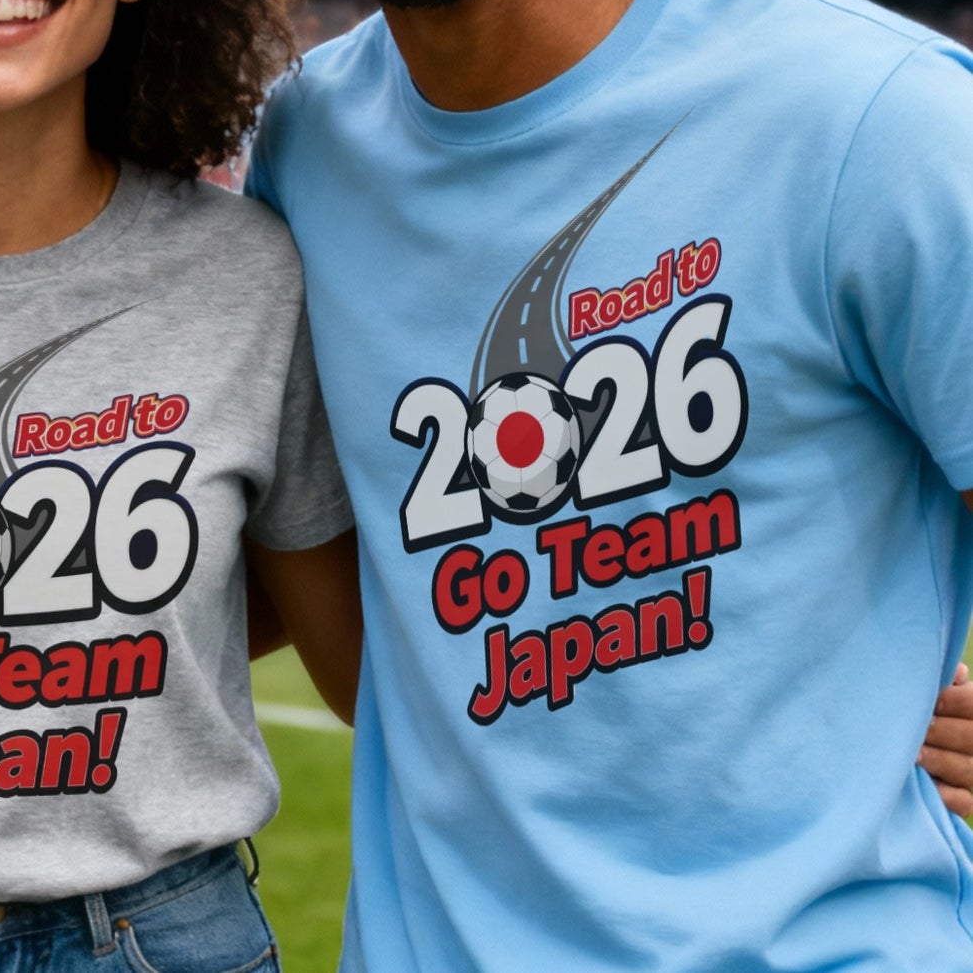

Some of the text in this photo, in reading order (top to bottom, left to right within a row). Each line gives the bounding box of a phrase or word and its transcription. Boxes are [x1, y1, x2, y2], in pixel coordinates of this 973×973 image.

[569, 237, 721, 339] Road to
[13, 392, 189, 458] Road to
[390, 293, 749, 554] 2026
[432, 488, 741, 635] Go Team
[467, 566, 713, 726] Japan!
